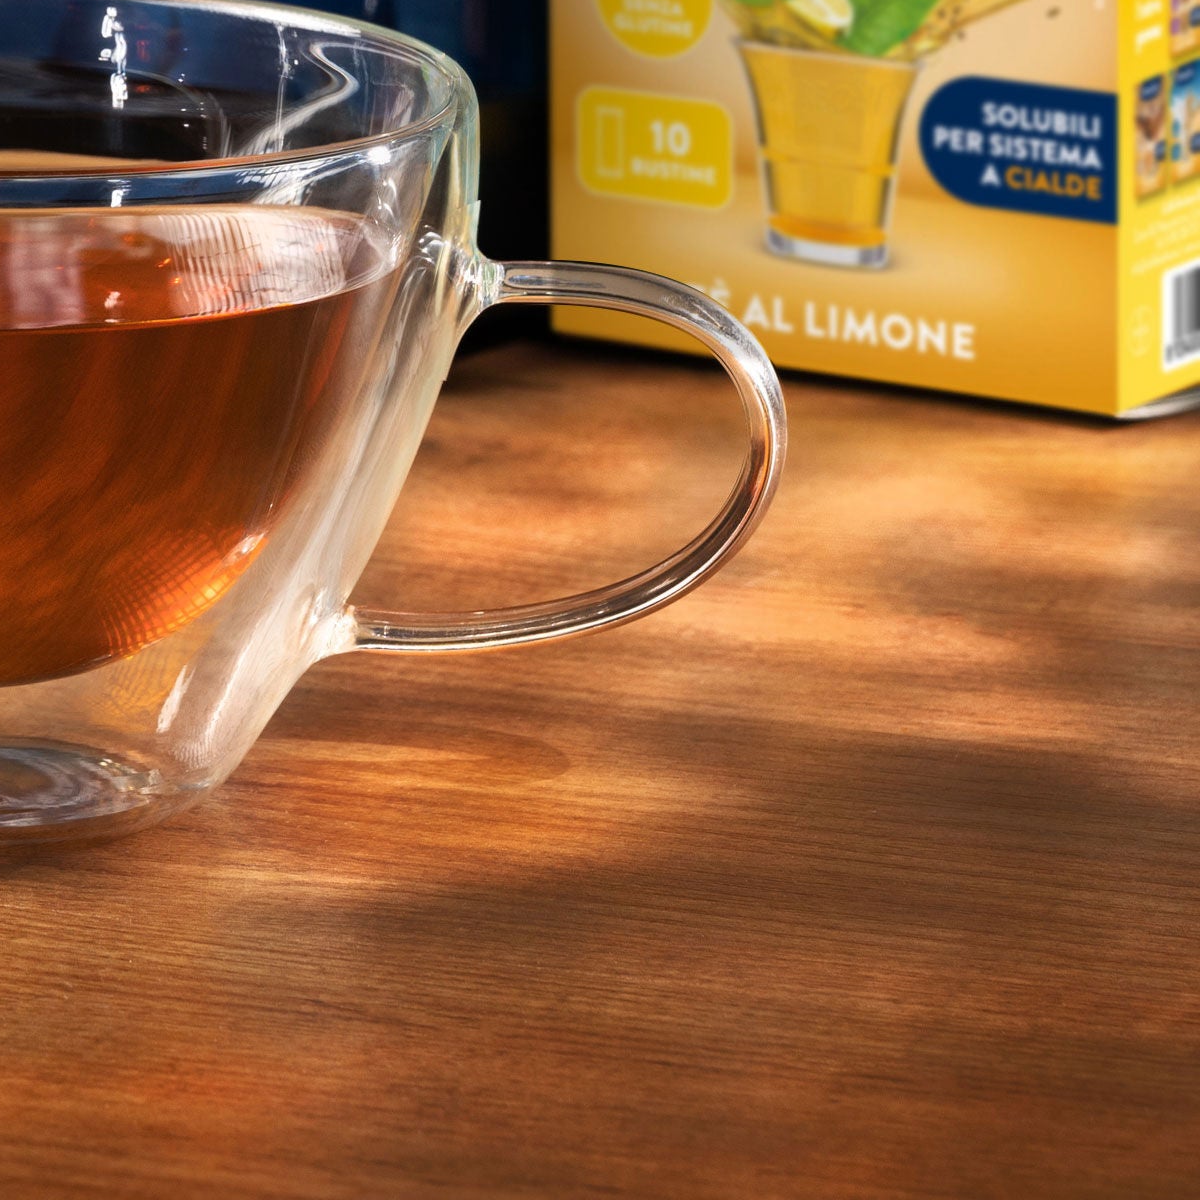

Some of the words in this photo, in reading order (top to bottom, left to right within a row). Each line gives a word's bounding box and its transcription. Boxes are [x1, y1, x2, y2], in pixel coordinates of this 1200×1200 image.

[650, 119, 692, 158] 10
[982, 101, 1101, 140] SOLUBILI
[933, 125, 983, 155] PER
[989, 132, 1102, 171] SISTEMA
[980, 163, 1000, 188] A
[1004, 164, 1102, 200] CIALDE
[742, 295, 795, 334] AL
[804, 300, 977, 361] LIMONE
